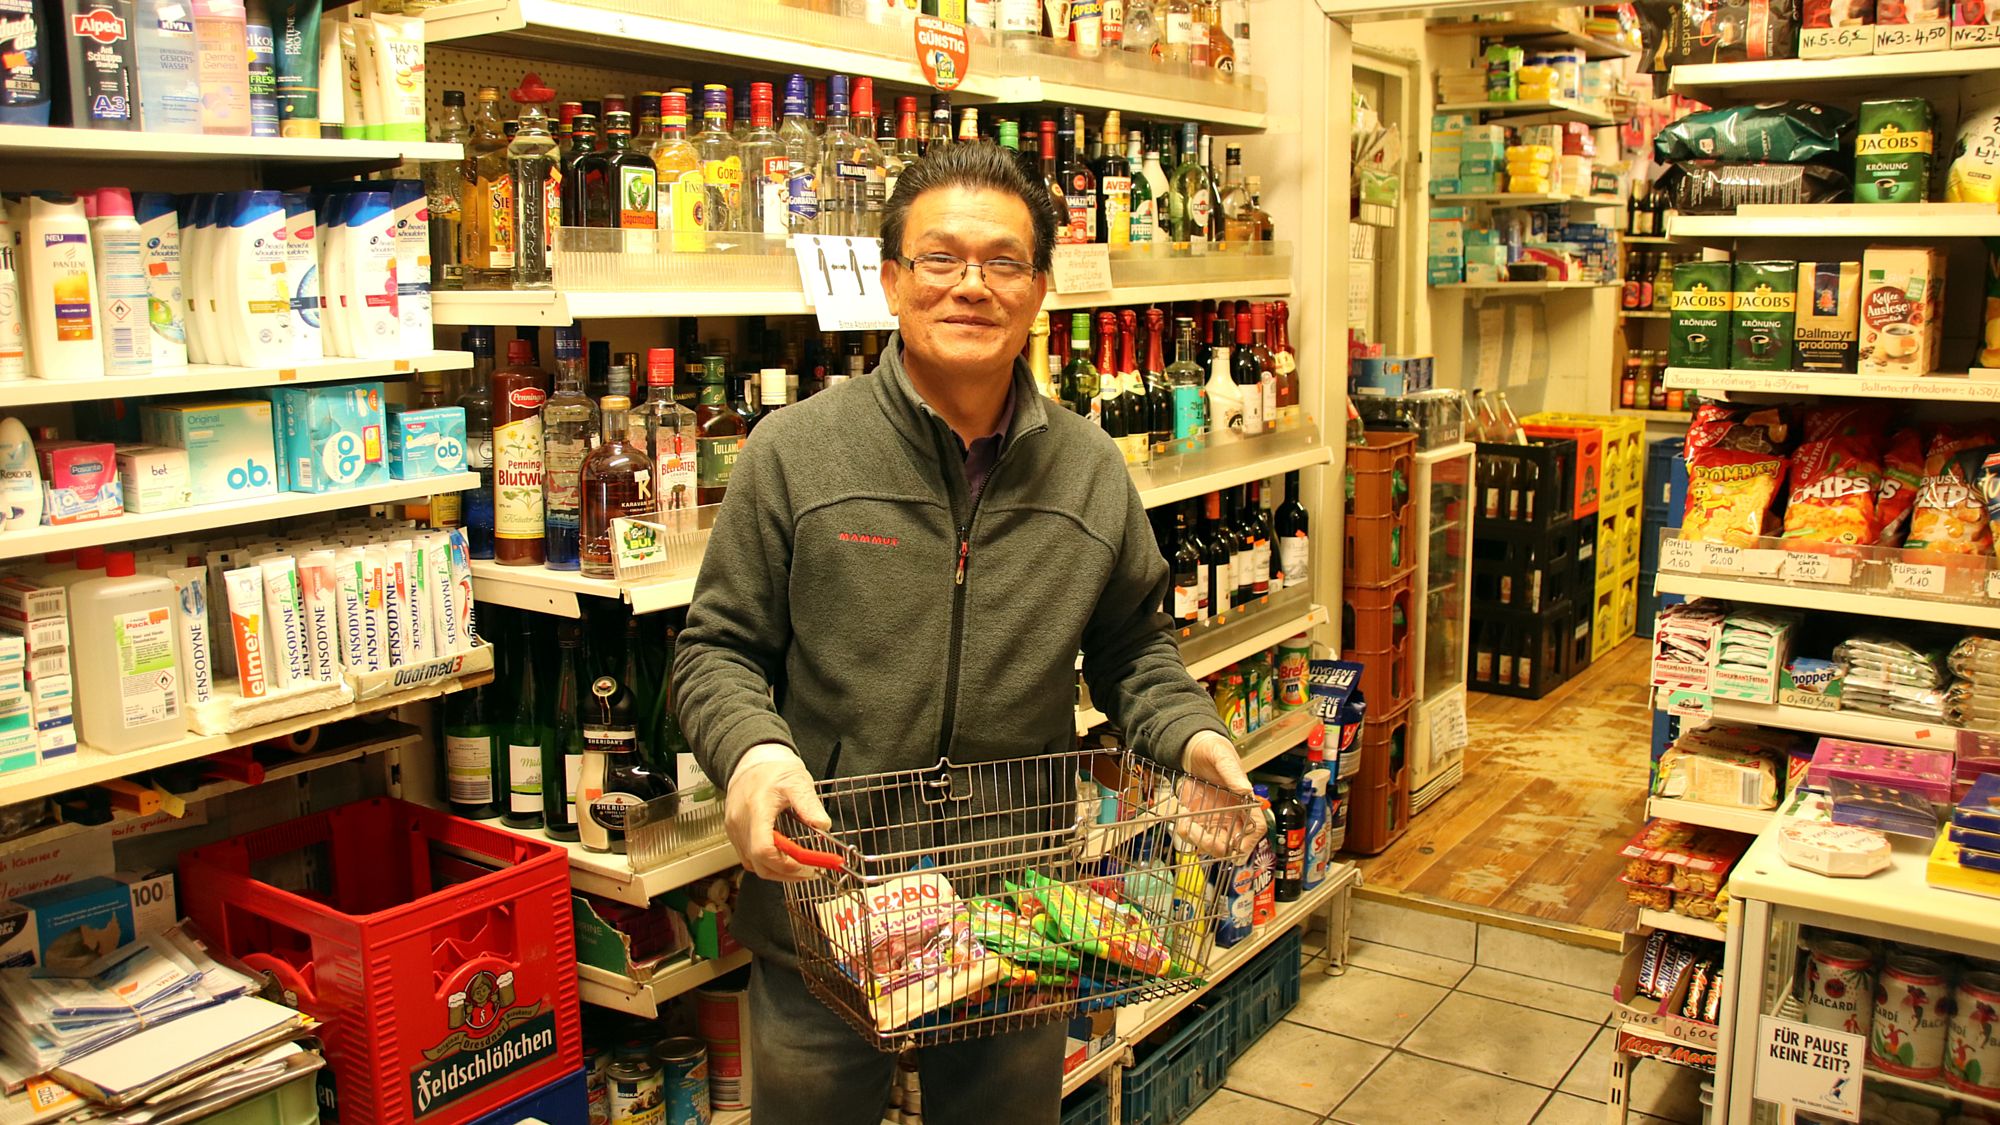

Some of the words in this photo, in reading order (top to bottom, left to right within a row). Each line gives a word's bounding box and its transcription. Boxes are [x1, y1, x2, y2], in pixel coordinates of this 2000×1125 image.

[13, 33, 37, 49] das
[919, 29, 965, 54] GÜNSTIG
[160, 62, 190, 70] WASSER
[94, 95, 125, 111] A3
[1859, 137, 1918, 152] JACOBS
[1865, 161, 1909, 172] KRÖNUNG
[46, 234, 64, 243] NEU
[1674, 295, 1726, 307] JACOBS
[1738, 296, 1791, 308] JACOBS
[1867, 302, 1911, 318] Auslese
[1679, 318, 1717, 328] KRÖNUNG
[1742, 319, 1781, 329] KRÖNUNG
[1796, 328, 1852, 341] Dallmayr
[1798, 341, 1849, 352] prodomo
[187, 414, 221, 425] Original
[839, 532, 900, 546] MAMMUT
[440, 575, 457, 645] SENSODYNE
[387, 578, 402, 667] SENSODYNE
[343, 594, 363, 668] SENSODYNE
[282, 605, 301, 680] SENSODYNE
[314, 604, 333, 684] SENSODYNE
[192, 622, 210, 704] SENSODYNE
[238, 621, 264, 696] elmex
[1279, 663, 1305, 678] Bref
[1310, 665, 1357, 678] HYGIENE
[590, 738, 626, 746] SHERIDAN'S
[132, 882, 164, 907] 100
[463, 1024, 507, 1050] Dresdner
[1774, 1026, 1800, 1047] FÜR
[1804, 1034, 1849, 1058] PAUSE
[1769, 1043, 1808, 1065] KEINE
[1812, 1053, 1851, 1074] ZEIT?
[416, 1028, 553, 1112] Feldschlößchen
